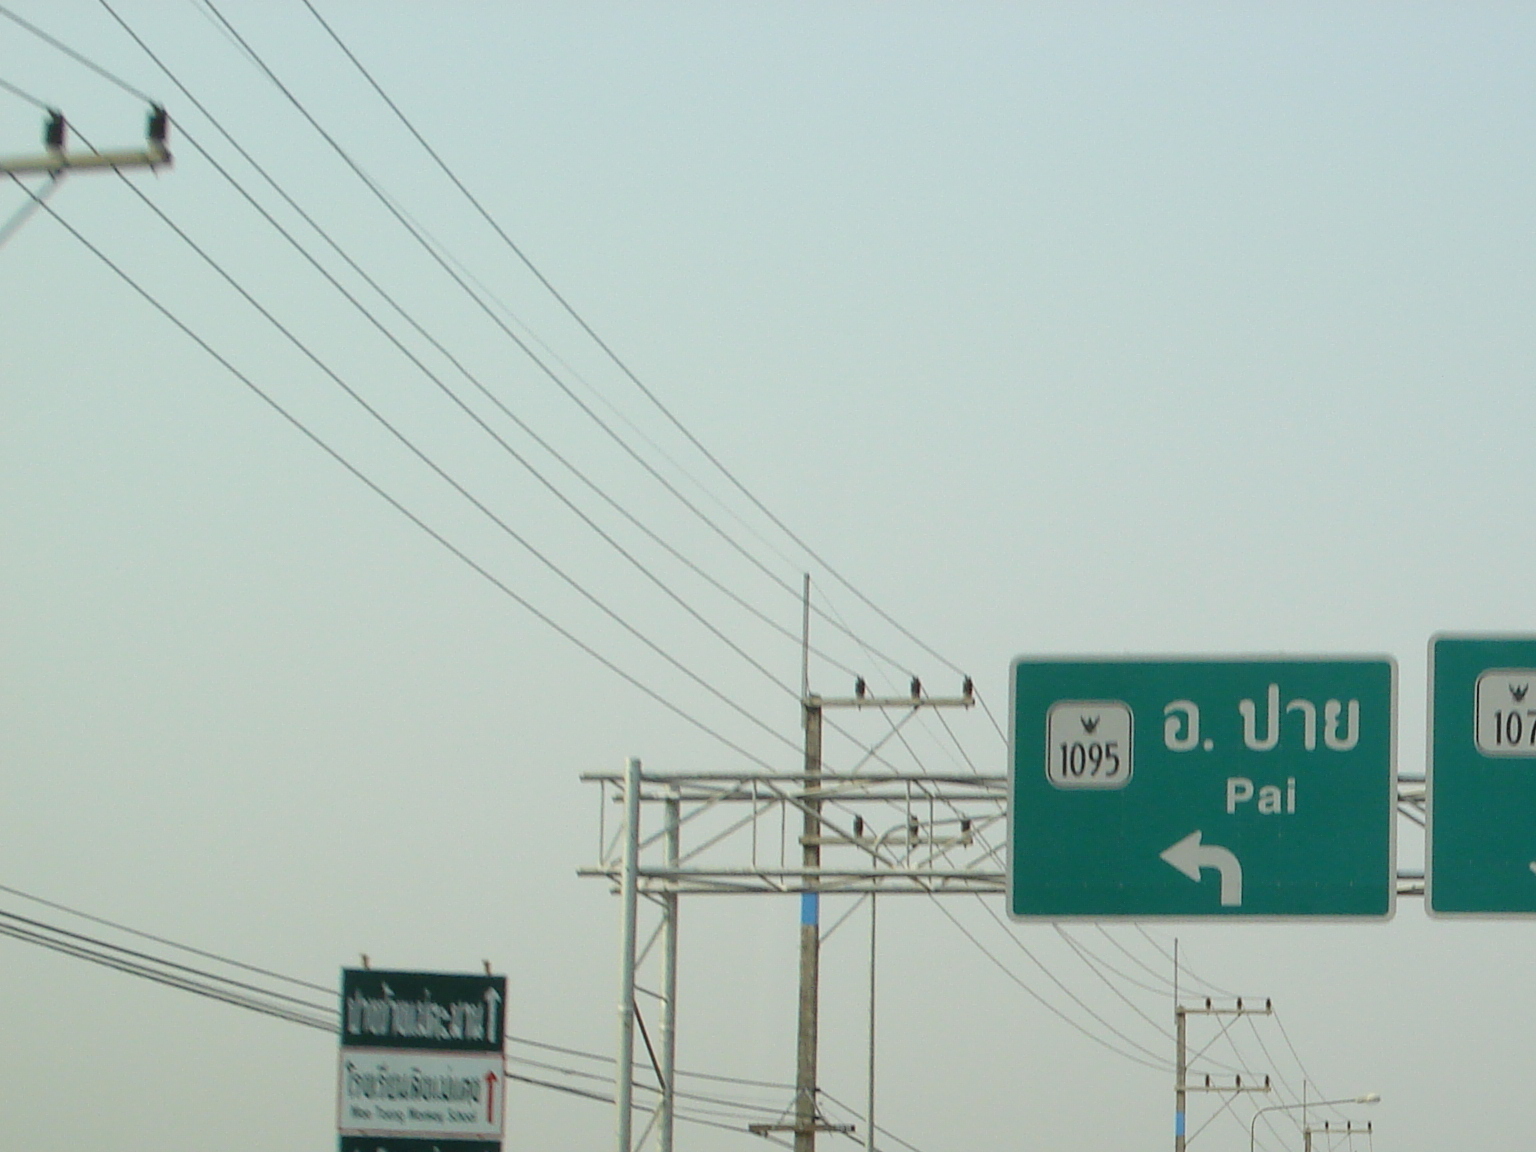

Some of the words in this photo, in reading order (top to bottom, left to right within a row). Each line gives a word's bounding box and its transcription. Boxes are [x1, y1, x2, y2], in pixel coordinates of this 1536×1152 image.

[1238, 682, 1361, 752] ปาย
[1060, 741, 1120, 777] 1095
[1226, 776, 1297, 815] Pai
